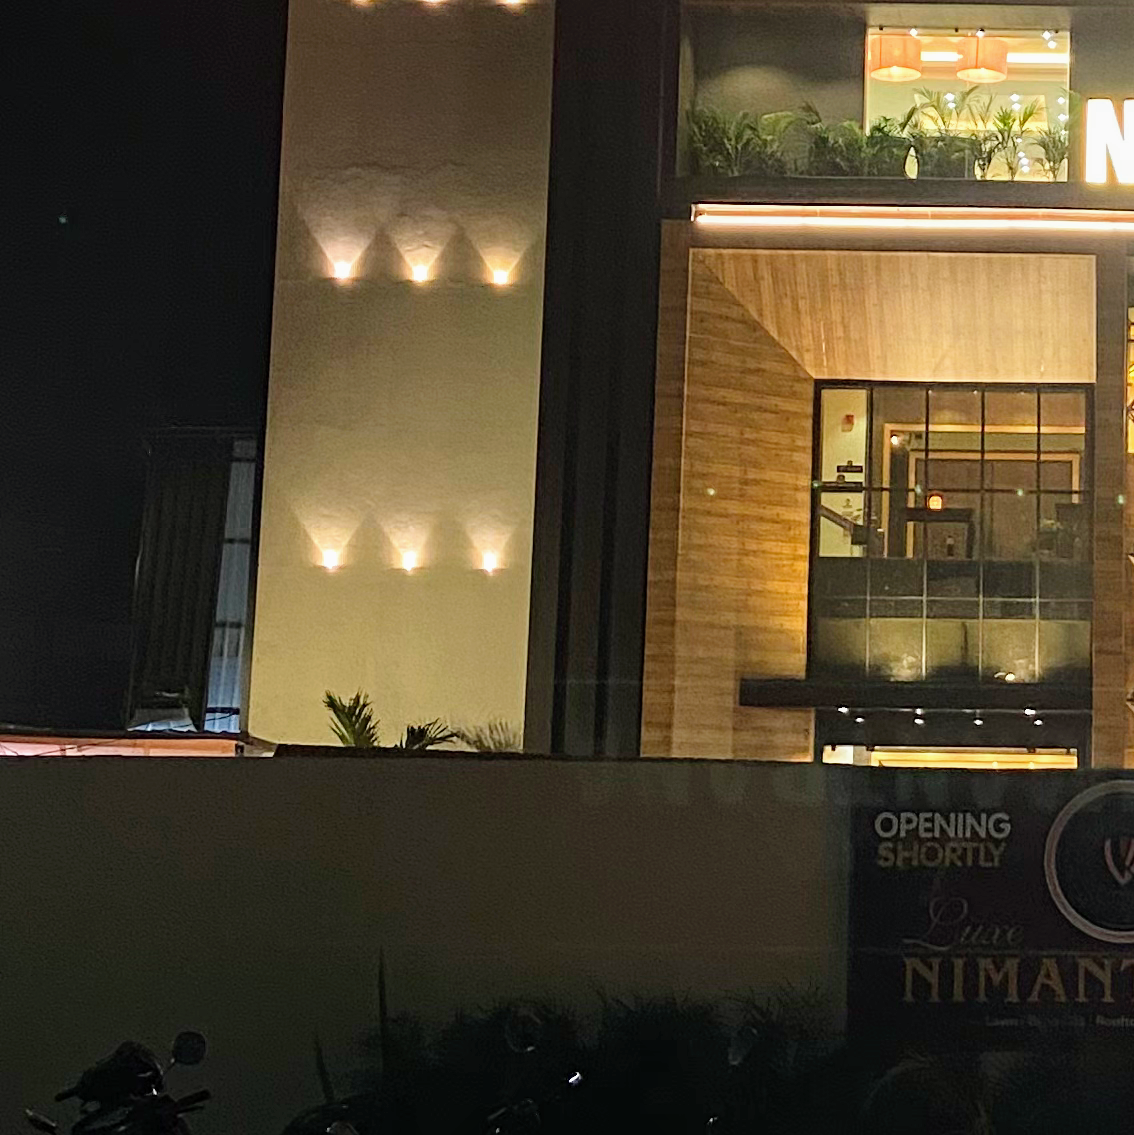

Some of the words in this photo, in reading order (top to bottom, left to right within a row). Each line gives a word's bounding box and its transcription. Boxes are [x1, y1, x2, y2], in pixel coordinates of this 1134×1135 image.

[874, 811, 1012, 839] OPENING
[877, 842, 1006, 868] SHORTLY
[902, 895, 1025, 951] Luxe
